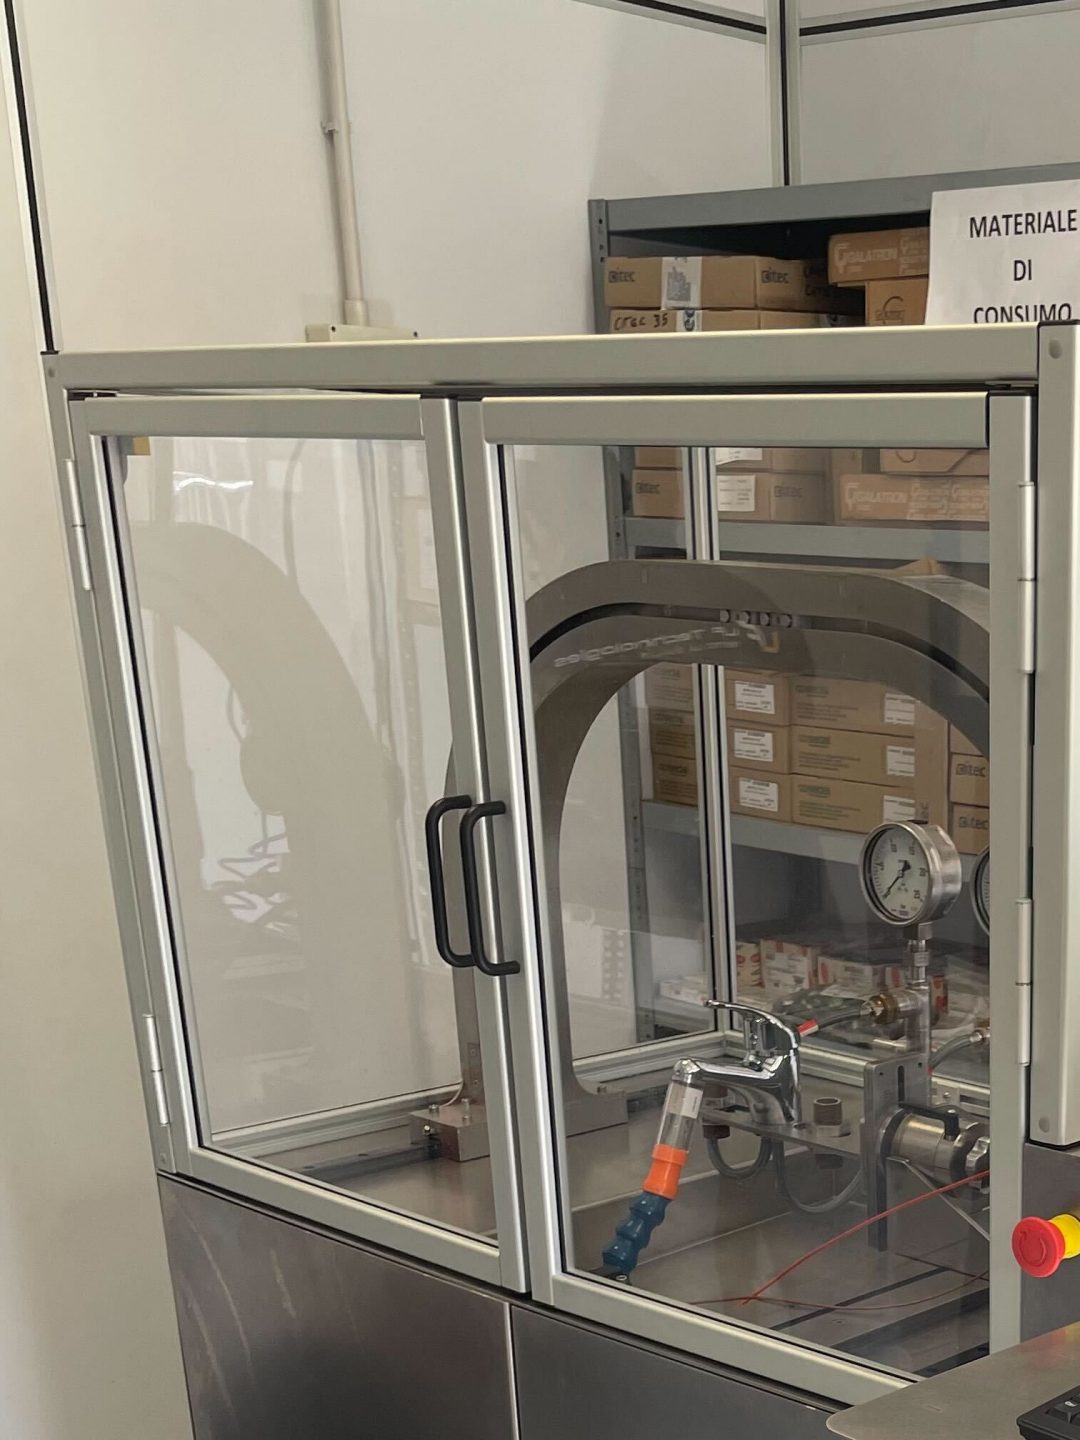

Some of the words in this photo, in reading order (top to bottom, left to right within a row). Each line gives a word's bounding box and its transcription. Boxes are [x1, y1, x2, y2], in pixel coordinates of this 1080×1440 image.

[969, 208, 1078, 239] MATERIALE
[1012, 259, 1033, 282] DI
[973, 302, 1073, 324] CONSUMO
